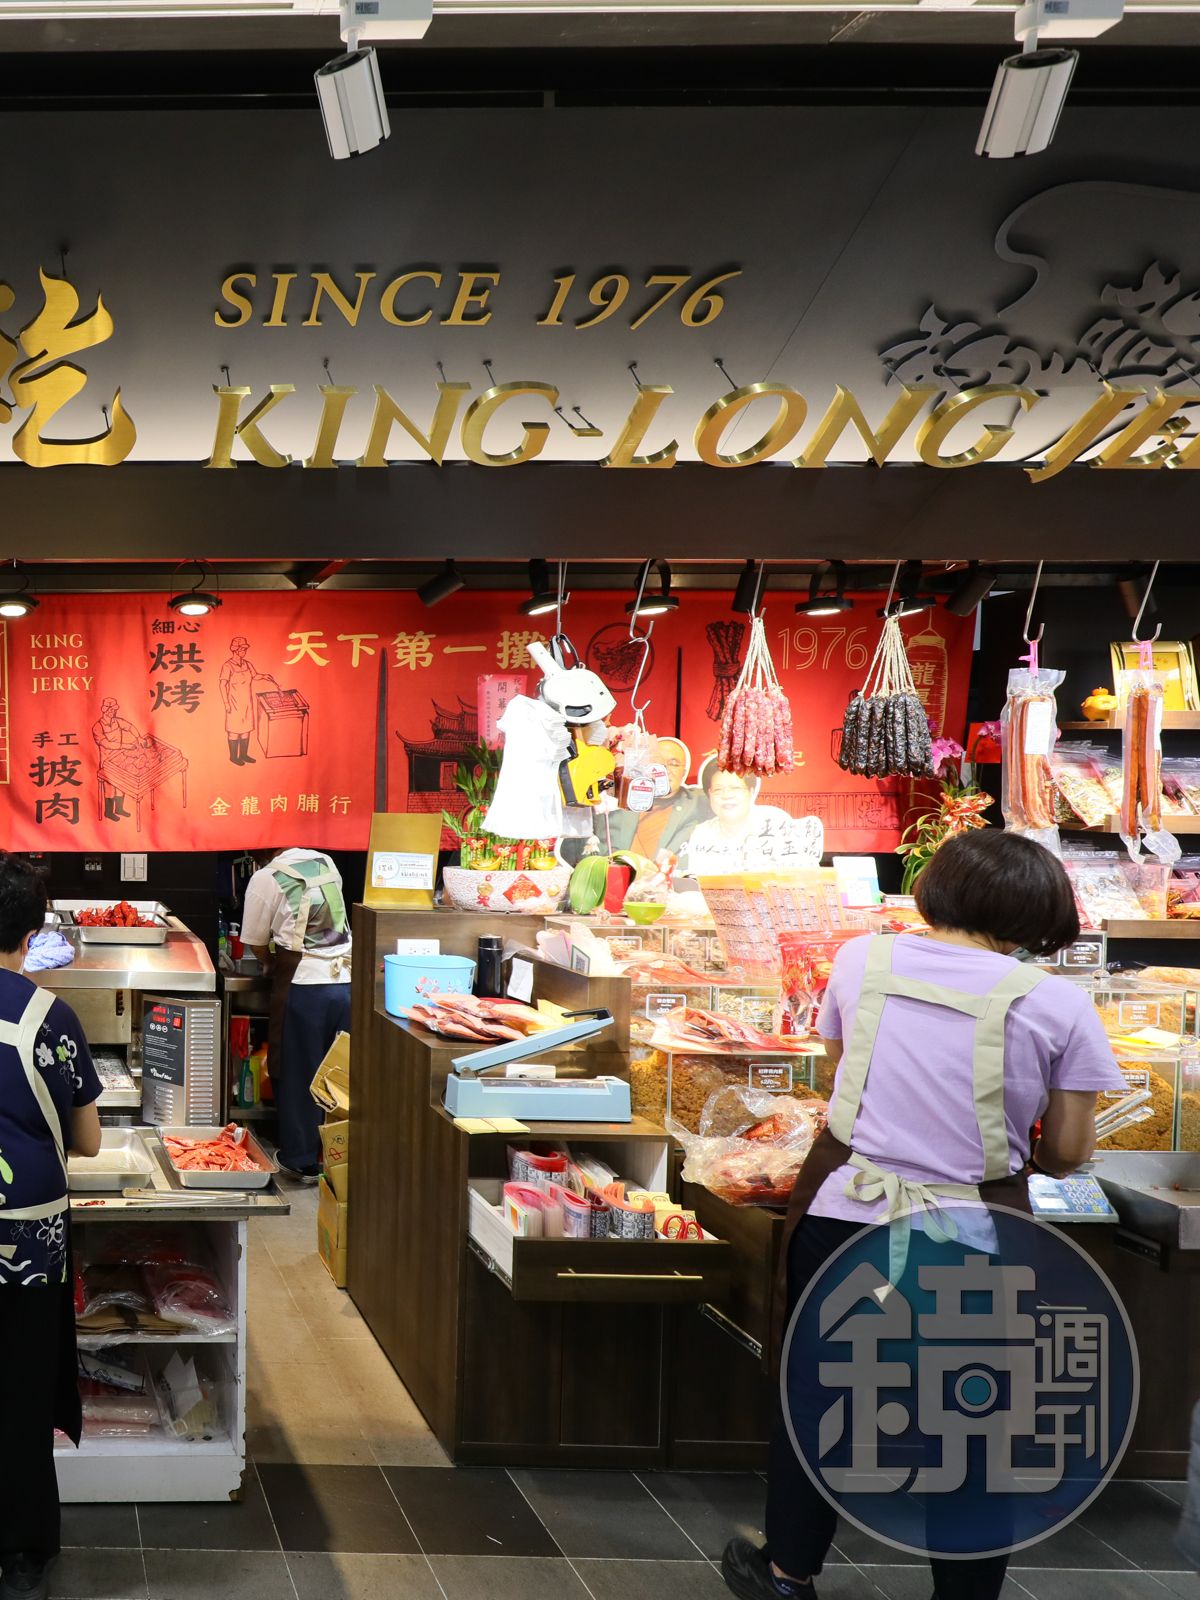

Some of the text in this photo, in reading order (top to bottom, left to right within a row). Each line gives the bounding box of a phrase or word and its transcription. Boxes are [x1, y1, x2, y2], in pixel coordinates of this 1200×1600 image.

[213, 270, 742, 330] SINCE 1976
[151, 618, 201, 635] 細心
[30, 633, 84, 648] KING
[778, 626, 868, 671] 1976
[30, 656, 90, 670] LONG
[31, 676, 94, 694] JERKY
[149, 642, 205, 714] 烘烤
[31, 731, 80, 747] 手工
[28, 755, 83, 825] 披肉
[209, 793, 353, 817] 金龍肉脯行
